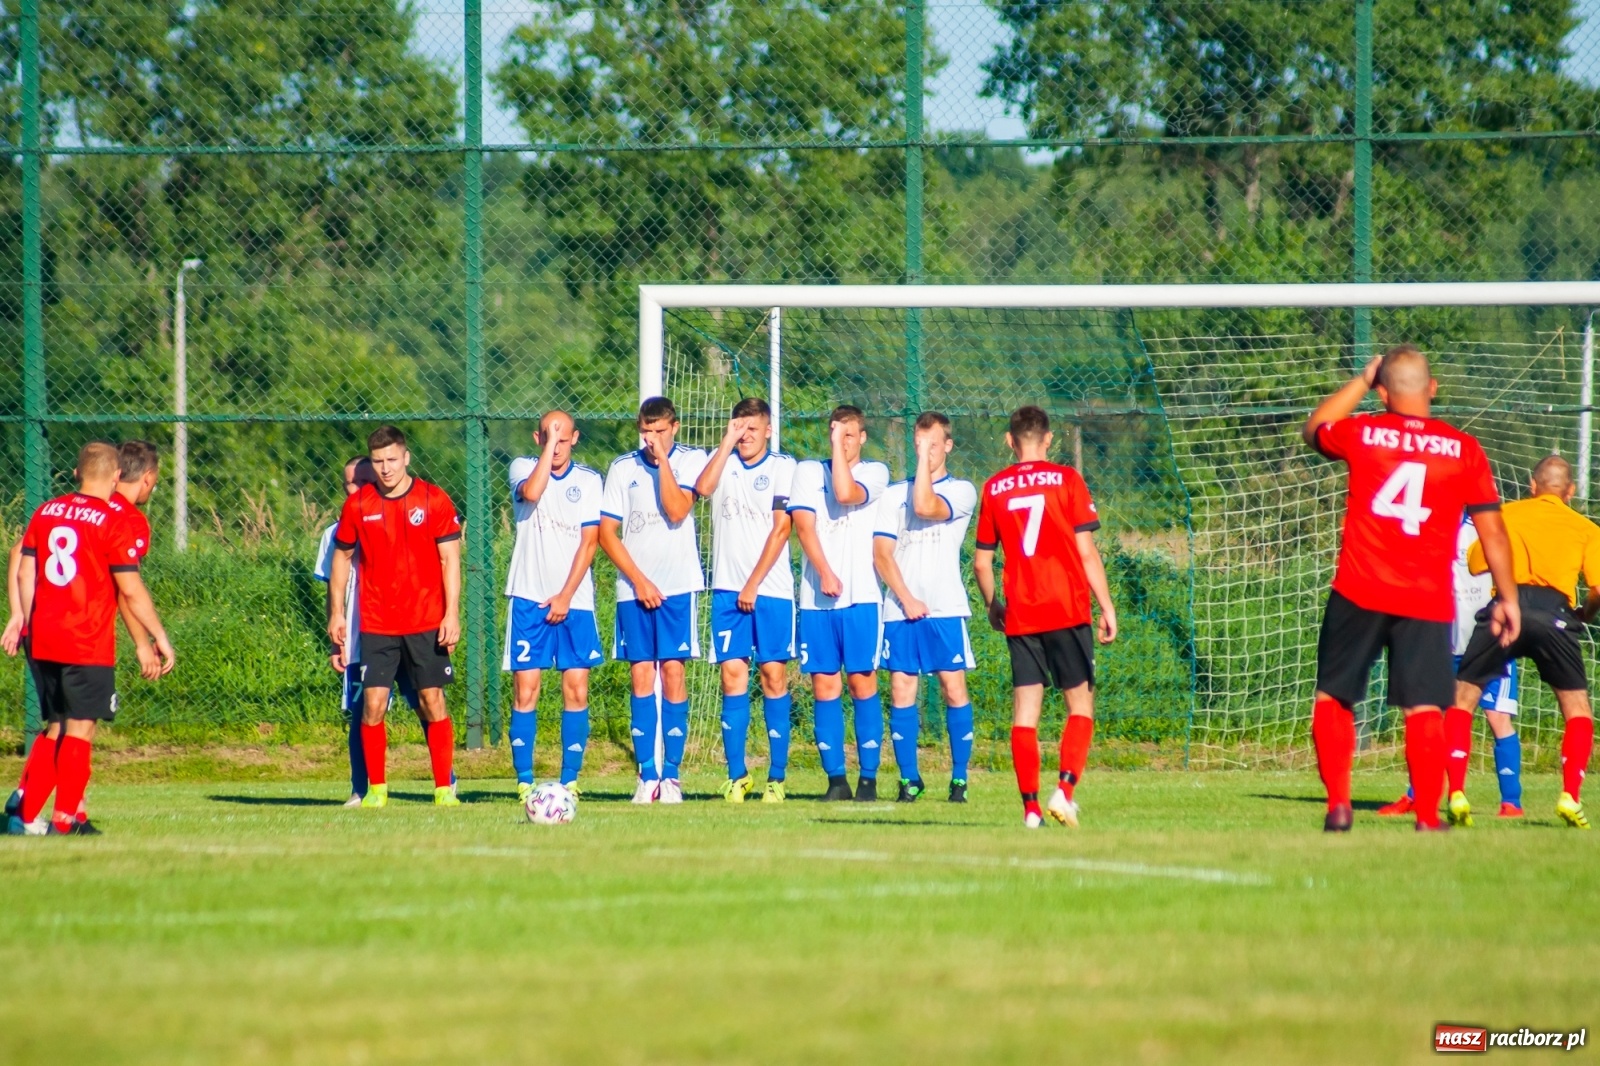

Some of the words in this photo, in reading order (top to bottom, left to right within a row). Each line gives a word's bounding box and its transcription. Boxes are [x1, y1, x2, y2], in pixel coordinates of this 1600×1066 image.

[1362, 425, 1400, 449] LKS
[1402, 432, 1462, 459] LYSKI
[991, 476, 1015, 496] LKS
[1017, 471, 1063, 489] LYSKI
[1371, 461, 1432, 536] 4
[41, 502, 66, 517] LKS
[64, 505, 106, 526] LYSKI
[1007, 494, 1046, 557] 7
[45, 526, 78, 587] 8
[516, 639, 531, 662] 2
[718, 629, 732, 653] 7
[352, 681, 363, 702] 7
